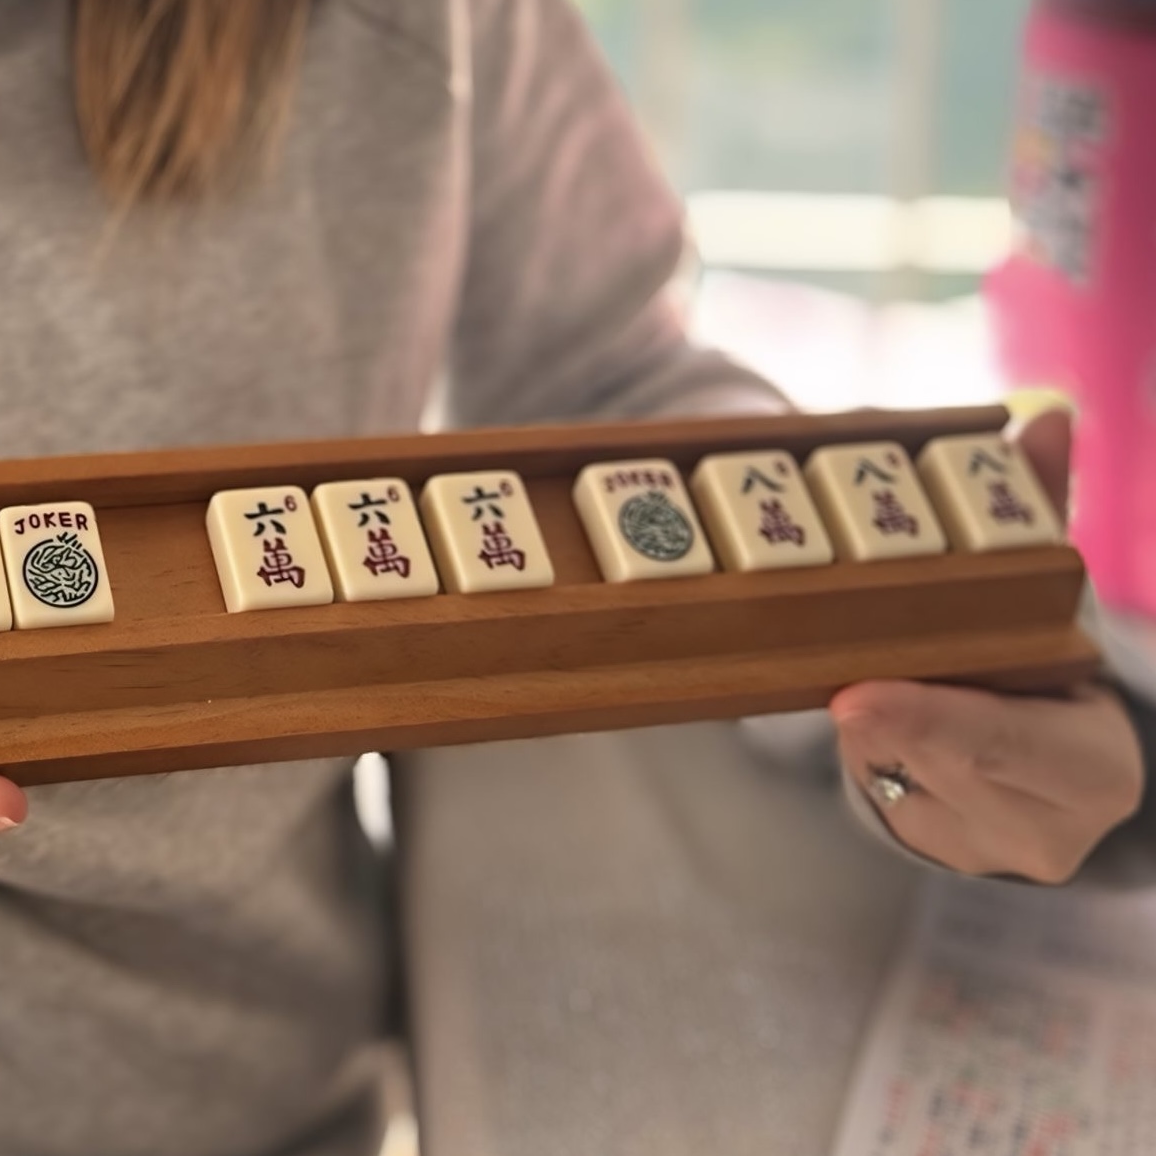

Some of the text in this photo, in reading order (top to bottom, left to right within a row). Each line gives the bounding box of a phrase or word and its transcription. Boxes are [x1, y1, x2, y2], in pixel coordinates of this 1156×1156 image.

[13, 511, 89, 536] JOKER
[244, 501, 305, 589] 六萬
[284, 495, 298, 512] 6
[348, 492, 410, 579] 六萬
[462, 485, 526, 572] 六萬
